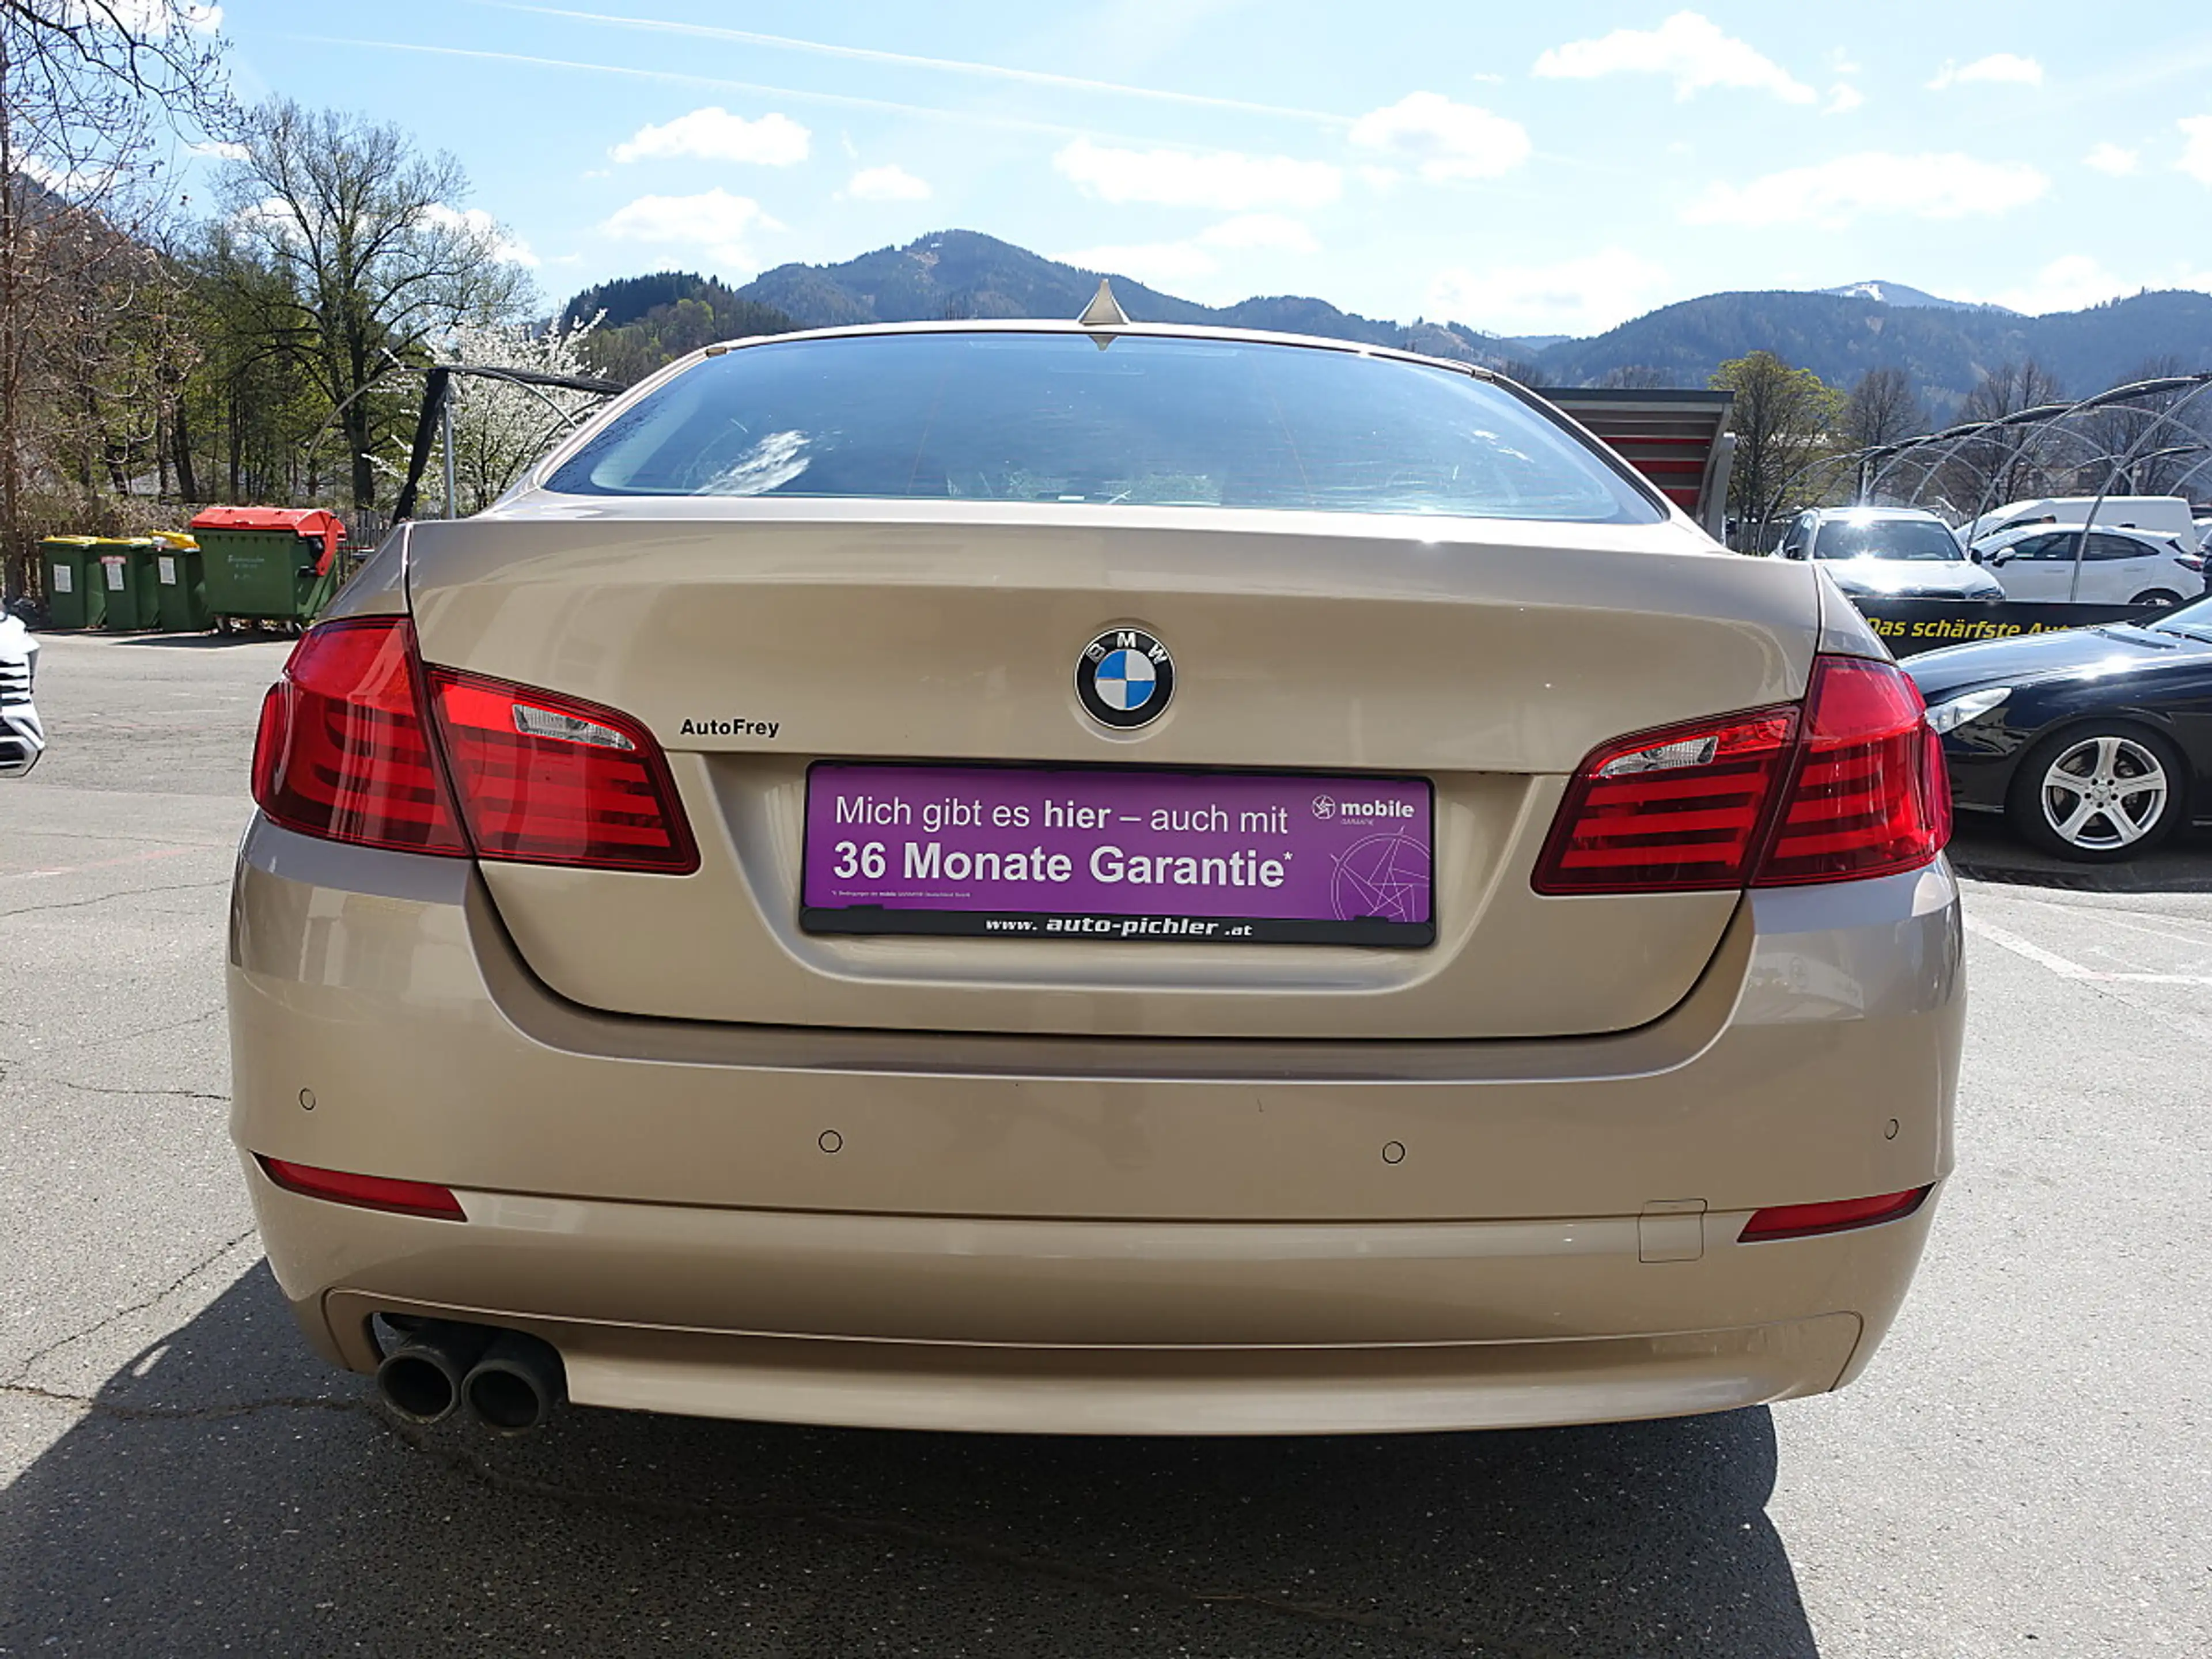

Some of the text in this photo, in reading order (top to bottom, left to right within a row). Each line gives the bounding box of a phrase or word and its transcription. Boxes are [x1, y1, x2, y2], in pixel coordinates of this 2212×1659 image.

[1911, 619, 2021, 639] schärfste
[1085, 632, 1168, 665] BMW
[680, 718, 779, 738] AutoFrey
[835, 796, 912, 825] Mich
[923, 798, 982, 833] gibt
[992, 805, 1030, 828] es
[1044, 799, 1112, 829] hier
[1150, 804, 1229, 833] auch
[1240, 805, 1289, 835] mit
[1340, 800, 1415, 818] mobile
[833, 841, 886, 879] 36
[903, 842, 1073, 882] Monate
[986, 917, 1253, 937] www. auto-pichler .at
